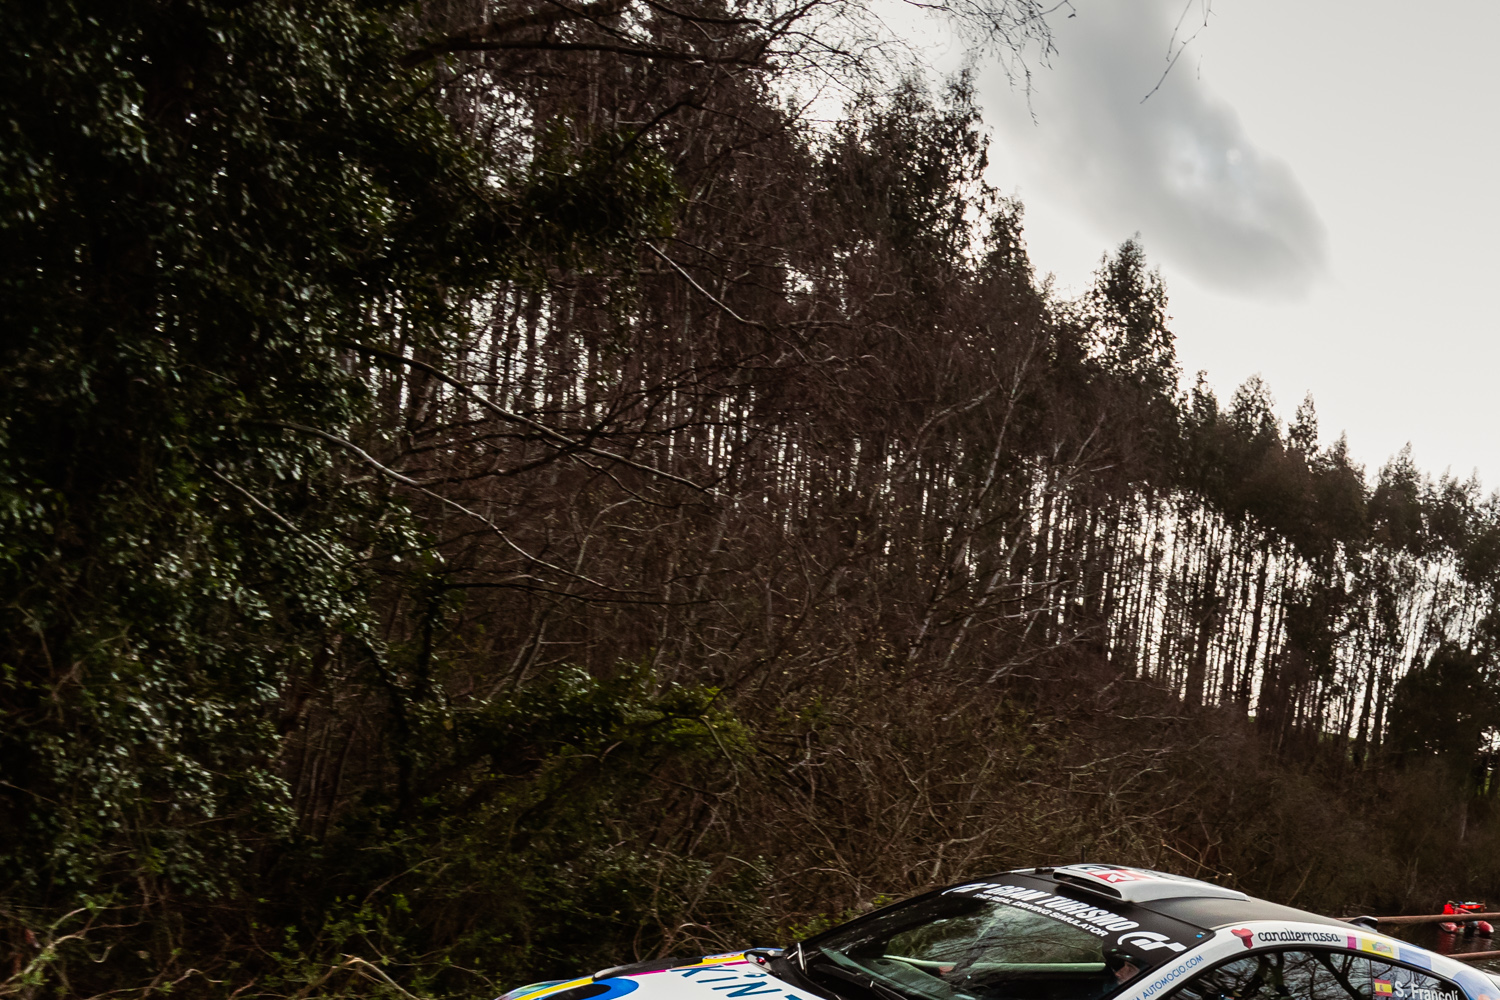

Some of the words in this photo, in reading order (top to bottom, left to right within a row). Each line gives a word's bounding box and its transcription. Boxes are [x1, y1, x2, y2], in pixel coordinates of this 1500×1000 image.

[1034, 895, 1140, 932] TURISMO
[1049, 911, 1109, 938] SIMULATOR
[1257, 927, 1341, 943] canalterrassa
[1394, 979, 1408, 998] S.
